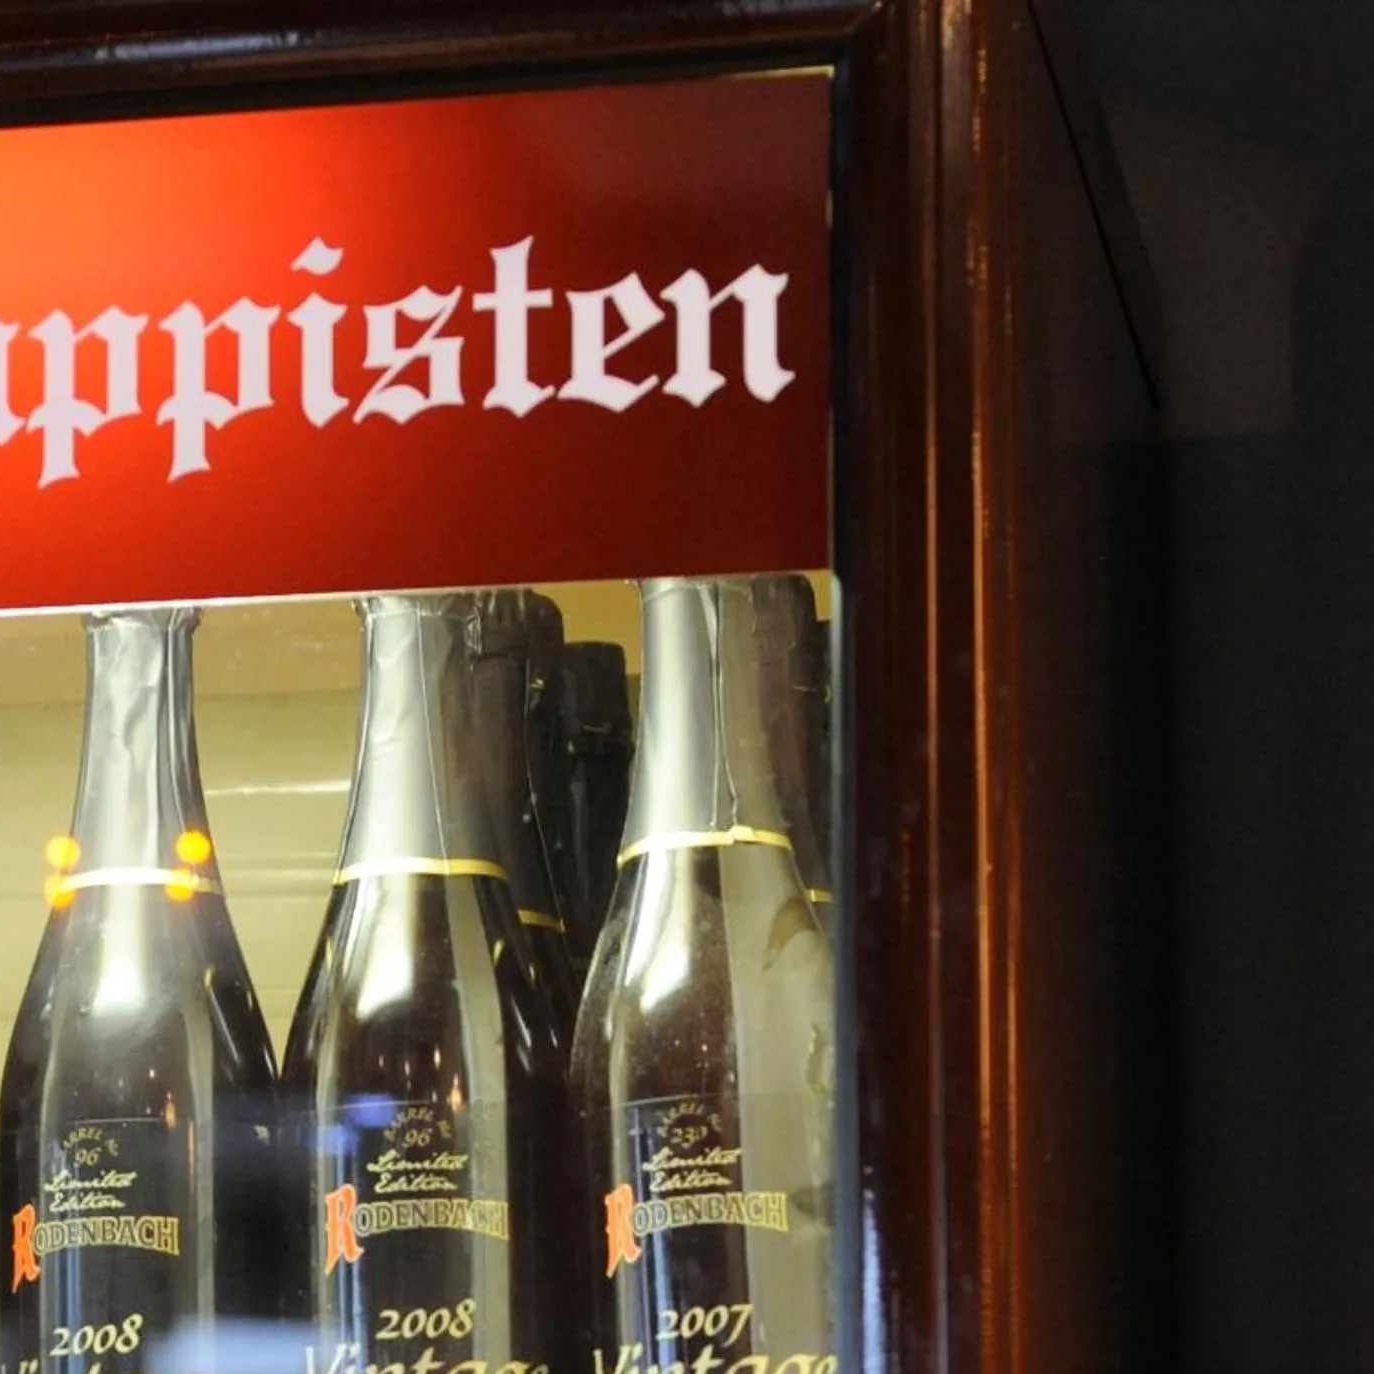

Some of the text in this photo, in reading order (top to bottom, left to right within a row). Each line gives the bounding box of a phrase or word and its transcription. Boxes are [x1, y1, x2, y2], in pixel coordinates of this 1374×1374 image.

[366, 1148, 470, 1173] Limited
[641, 1146, 743, 1172] Limited
[44, 1169, 138, 1192] Limited
[374, 1172, 459, 1194] Edition
[649, 1169, 733, 1193] Edition
[49, 1191, 127, 1213] Edition
[324, 1183, 510, 1276] RODENBACH
[605, 1183, 789, 1278] RODENBACH
[11, 1203, 181, 1294] RODENBACH
[50, 1313, 144, 1357] 2008
[375, 1299, 477, 1341] 2008
[655, 1303, 754, 1345] 2007
